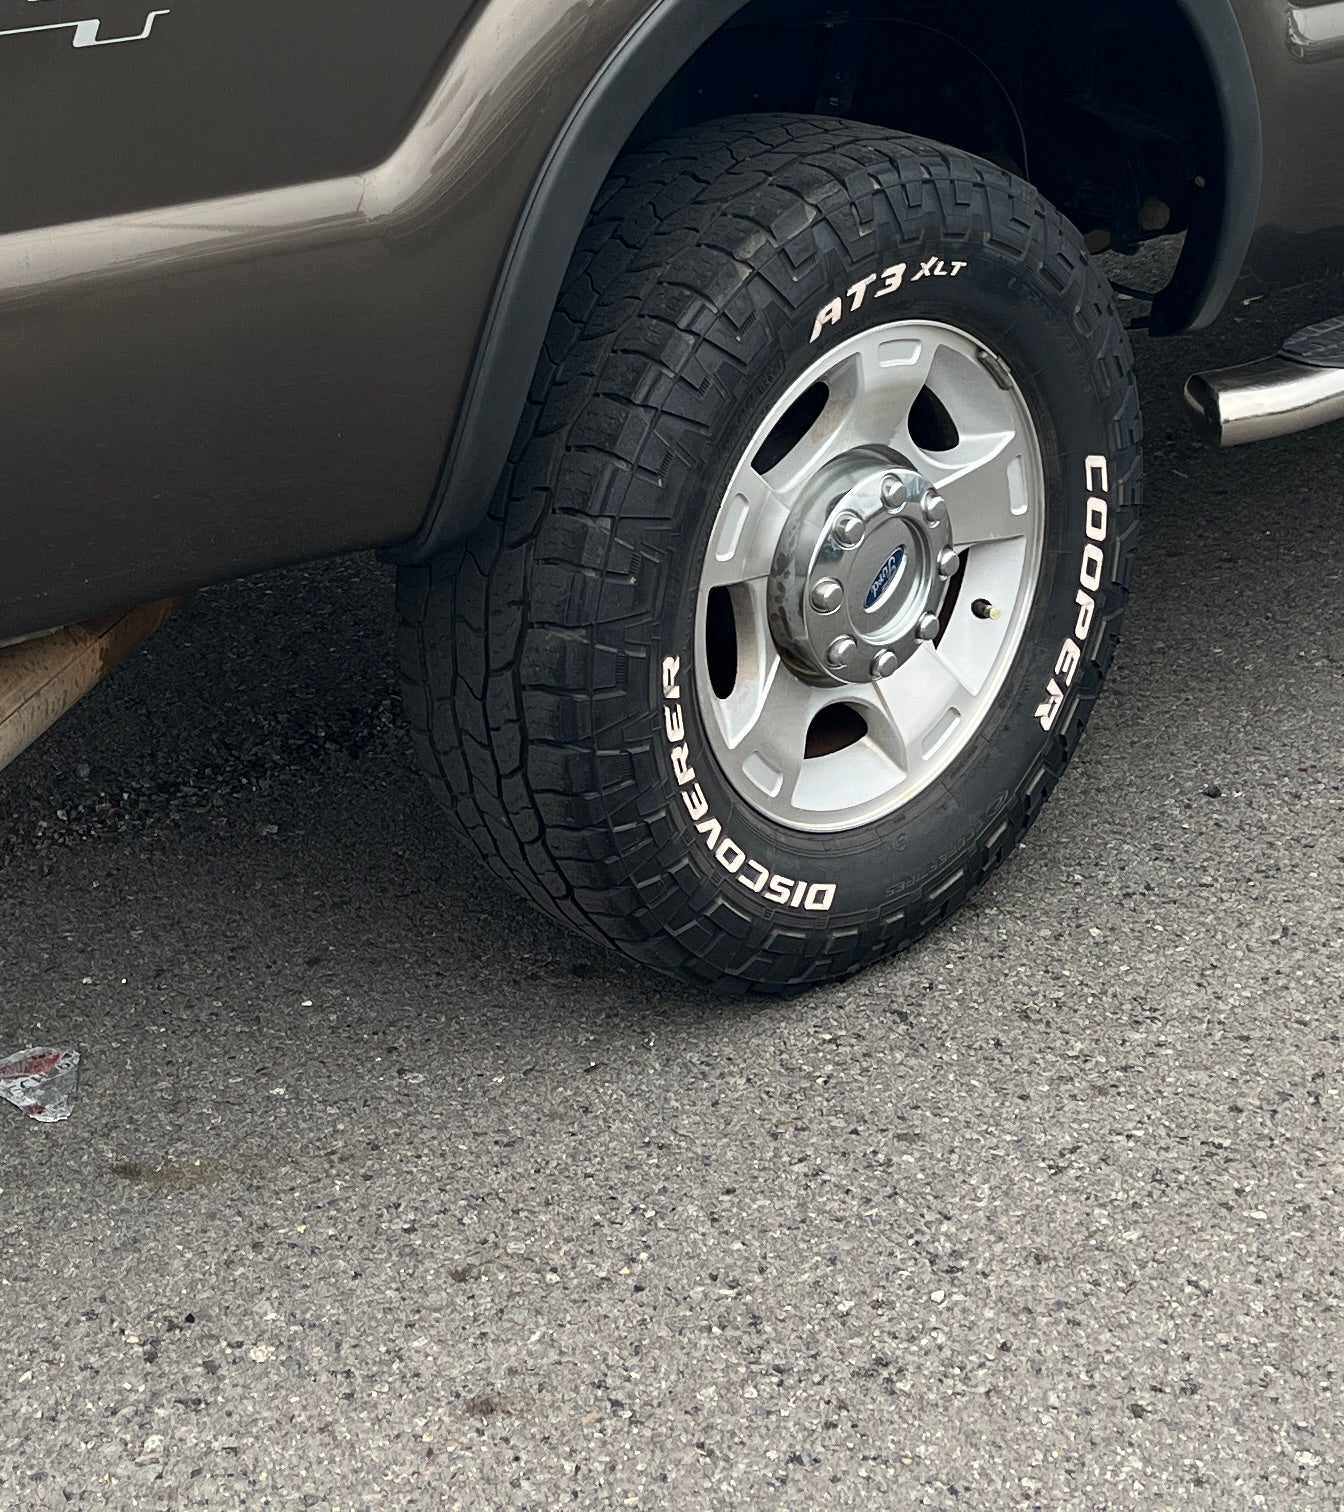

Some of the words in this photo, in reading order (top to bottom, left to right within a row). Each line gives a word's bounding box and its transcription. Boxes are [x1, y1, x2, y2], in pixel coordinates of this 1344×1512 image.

[809, 262, 907, 344] AT3
[910, 256, 968, 282] XLT
[870, 555, 897, 599] Ford
[1032, 454, 1111, 735] COOPER
[659, 654, 837, 913] DISCOVERER
